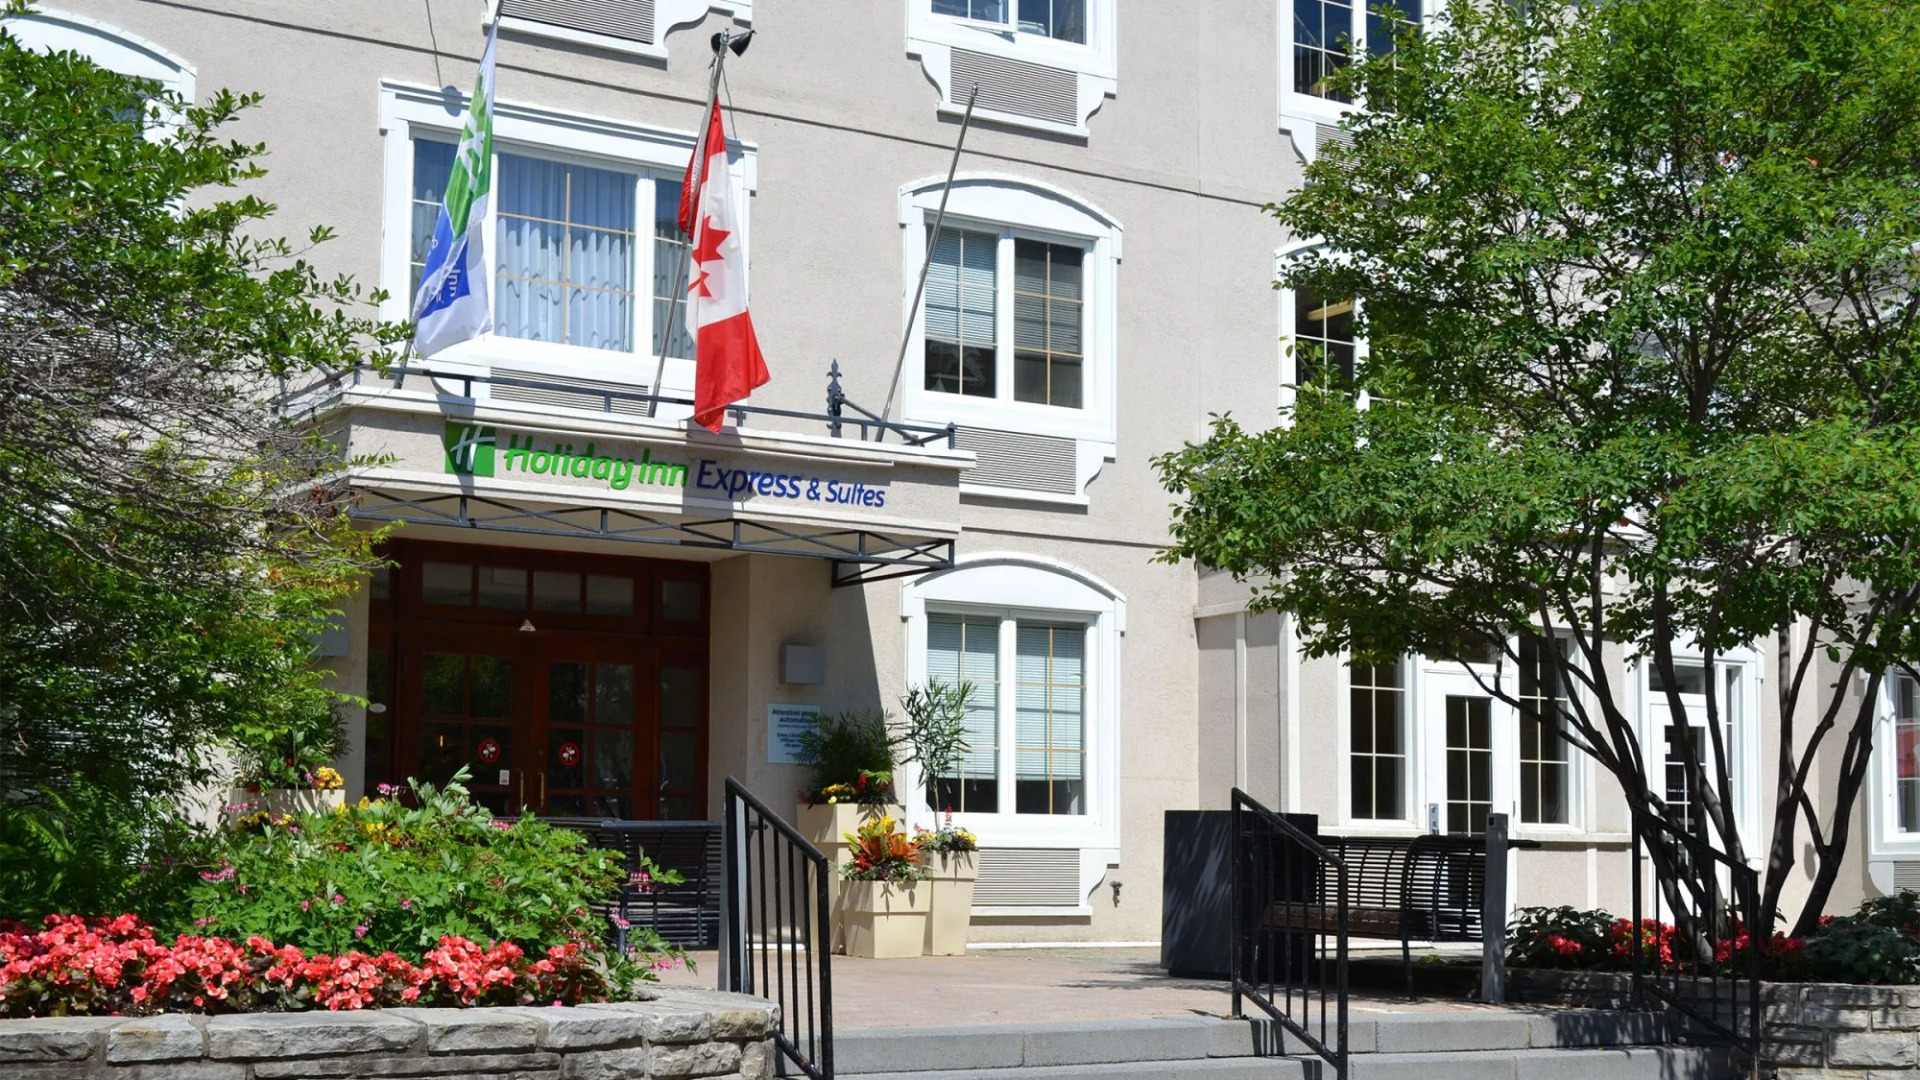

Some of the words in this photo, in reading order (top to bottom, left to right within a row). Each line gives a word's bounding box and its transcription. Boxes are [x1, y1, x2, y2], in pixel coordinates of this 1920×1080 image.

[504, 434, 634, 490] Holiday
[638, 448, 688, 488] Inn
[696, 459, 802, 499] Express
[806, 477, 821, 501] &
[825, 480, 885, 508] Suites
